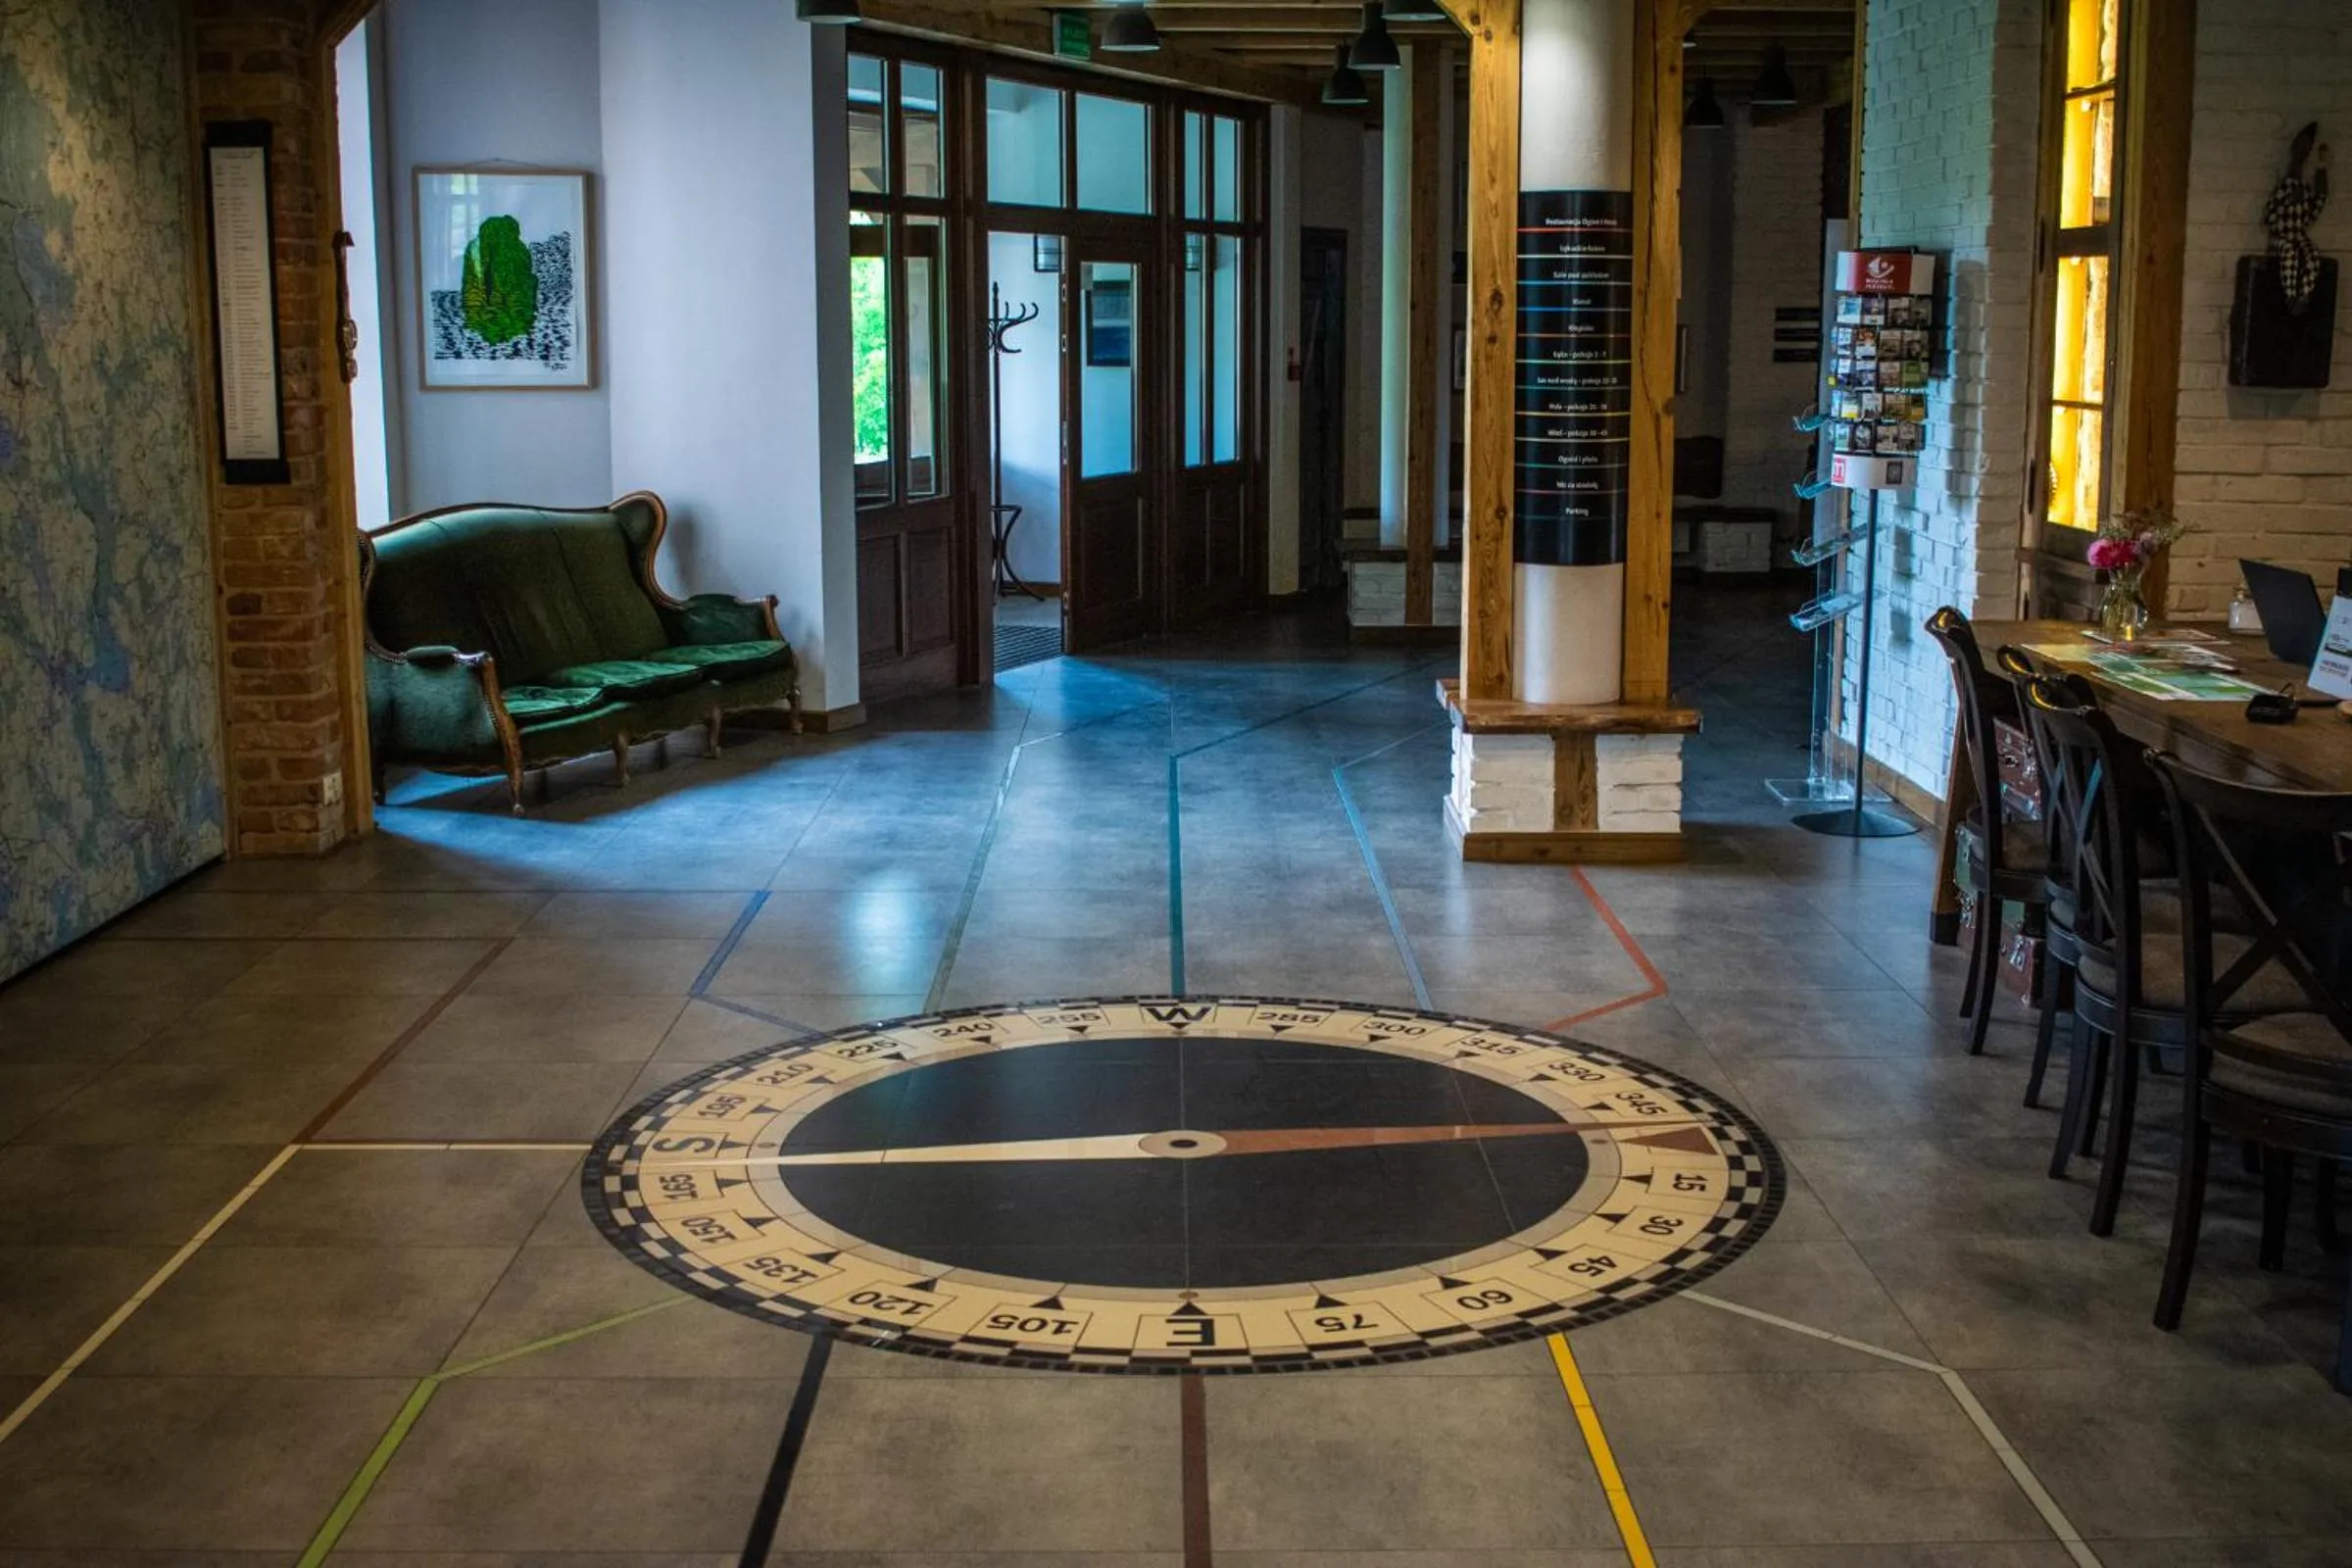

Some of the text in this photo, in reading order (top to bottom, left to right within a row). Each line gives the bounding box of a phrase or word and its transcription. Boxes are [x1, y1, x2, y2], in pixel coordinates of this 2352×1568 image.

[1037, 1012, 1102, 1026] 255
[1144, 1005, 1213, 1022] W
[1256, 1011, 1326, 1025] 285
[932, 1020, 995, 1039] 240
[1364, 1021, 1427, 1037] 300
[837, 1040, 901, 1058] 225
[1461, 1036, 1523, 1056] 315
[756, 1063, 815, 1085] 210
[1547, 1060, 1606, 1082] 330
[697, 1095, 746, 1119] 195
[1613, 1091, 1668, 1116] 345
[653, 1135, 715, 1154] S
[660, 1173, 699, 1201] 165
[1672, 1173, 1706, 1193] 15
[682, 1216, 737, 1244] 150
[1639, 1215, 1685, 1236] 30
[743, 1255, 822, 1284] 135
[1566, 1254, 1620, 1278] 45
[849, 1291, 935, 1315] 120
[1455, 1290, 1514, 1311] 60
[987, 1313, 1083, 1336] 105
[1166, 1318, 1214, 1347] E
[1314, 1313, 1379, 1334] 75
